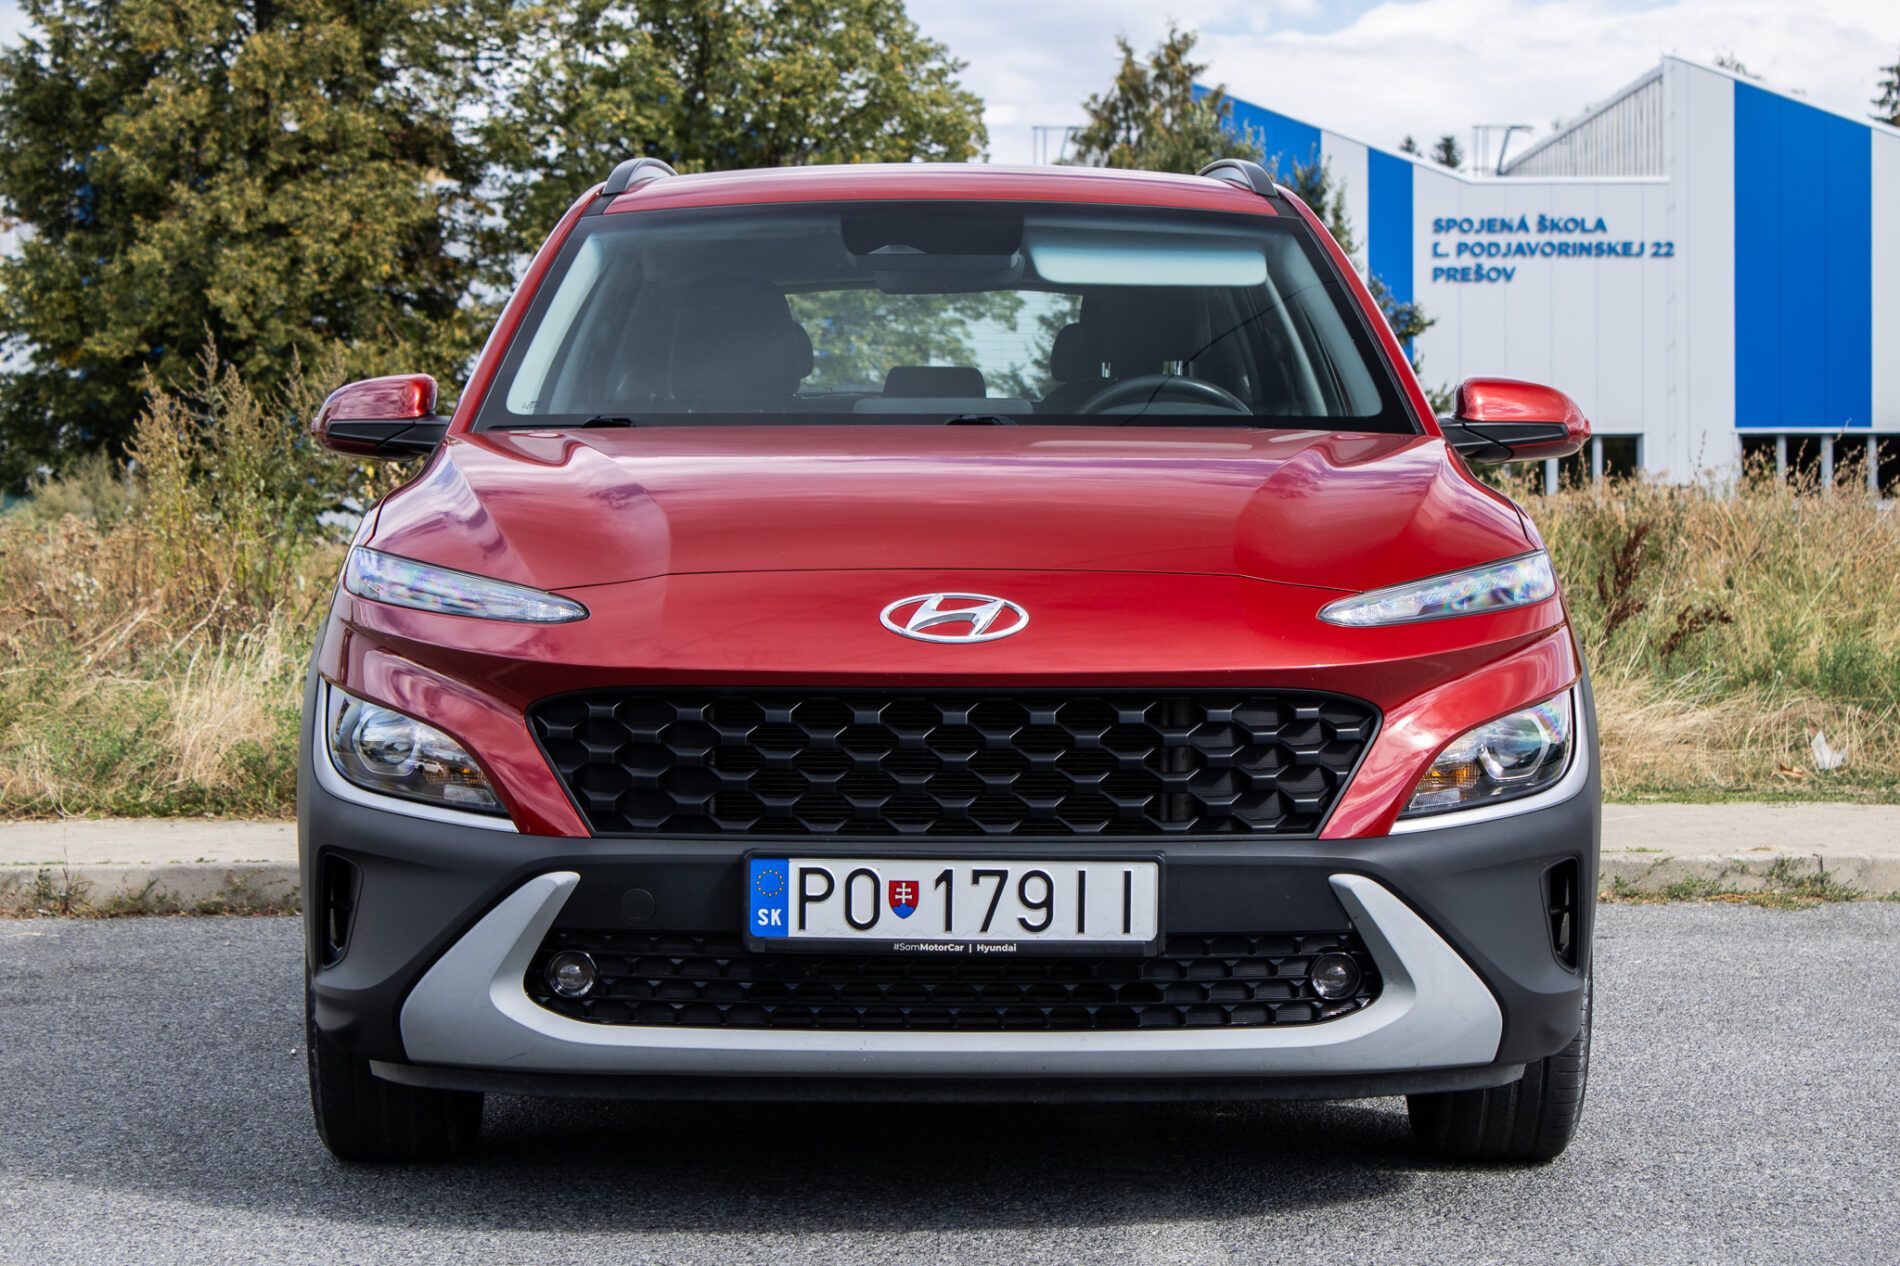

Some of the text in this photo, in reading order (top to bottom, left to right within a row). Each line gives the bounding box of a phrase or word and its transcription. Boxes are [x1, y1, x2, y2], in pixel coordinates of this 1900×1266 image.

[1432, 213, 1607, 234] SPOJENÁ ŠKOLA
[1456, 241, 1645, 259] PODJAVORINSKEJ
[1650, 241, 1675, 258] 22
[1432, 263, 1516, 283] PREŠOV
[798, 866, 882, 932] PO
[757, 908, 782, 926] SK
[893, 942, 965, 952] #SomMotorCar
[976, 943, 1017, 954] Hyundai
